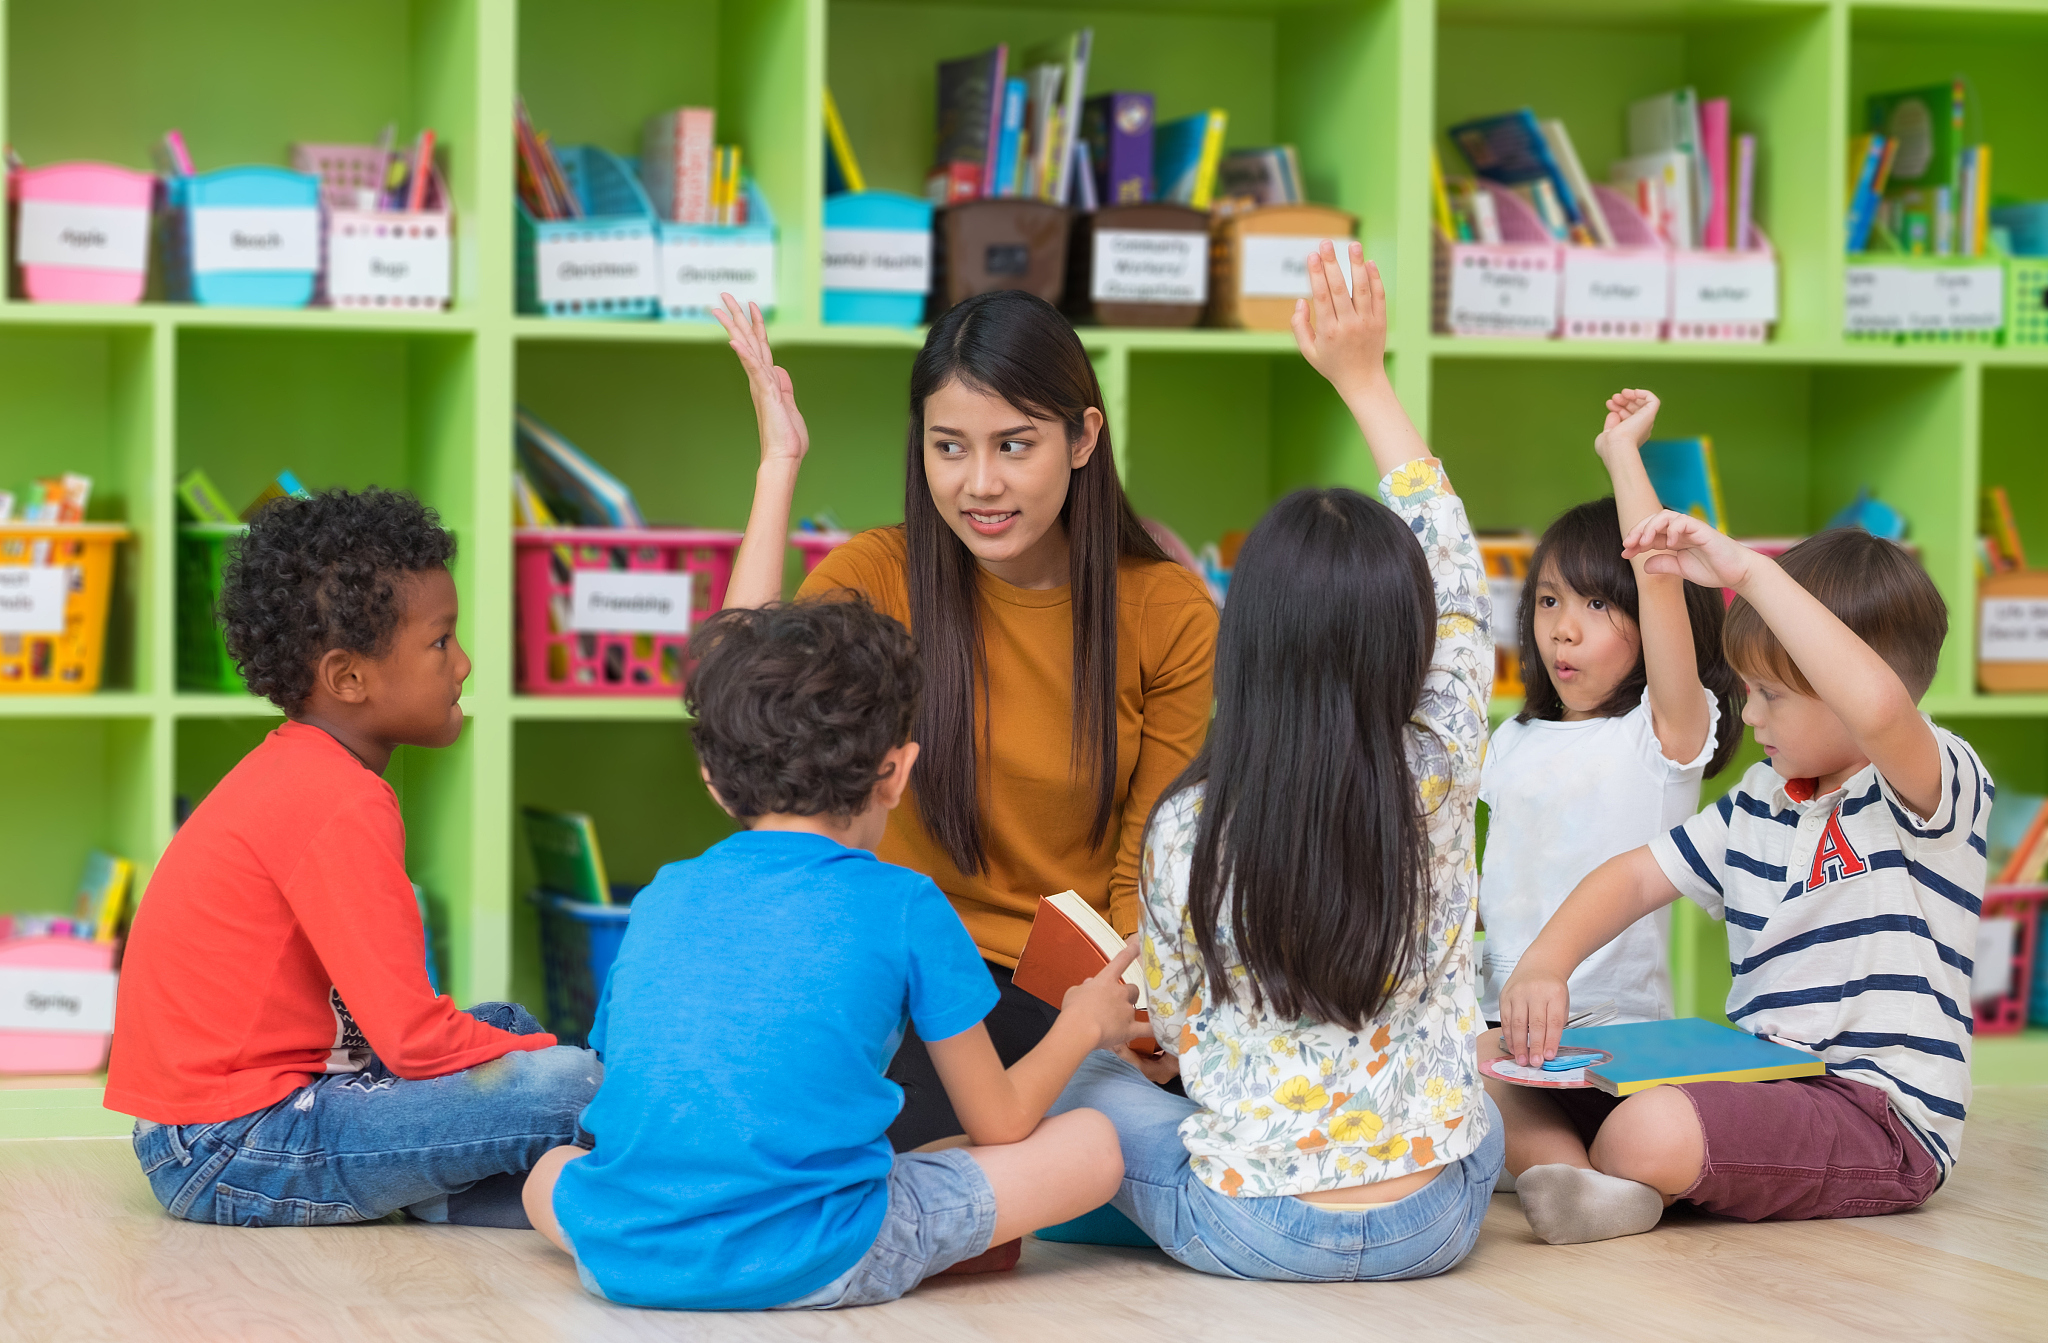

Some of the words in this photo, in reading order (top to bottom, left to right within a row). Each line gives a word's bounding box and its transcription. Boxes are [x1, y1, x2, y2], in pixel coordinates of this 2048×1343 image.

[558, 261, 639, 280] Christmas
[678, 265, 758, 284] Christmas
[588, 592, 675, 617] Friendship
[1805, 800, 1868, 893] A
[24, 991, 83, 1017] Spring
